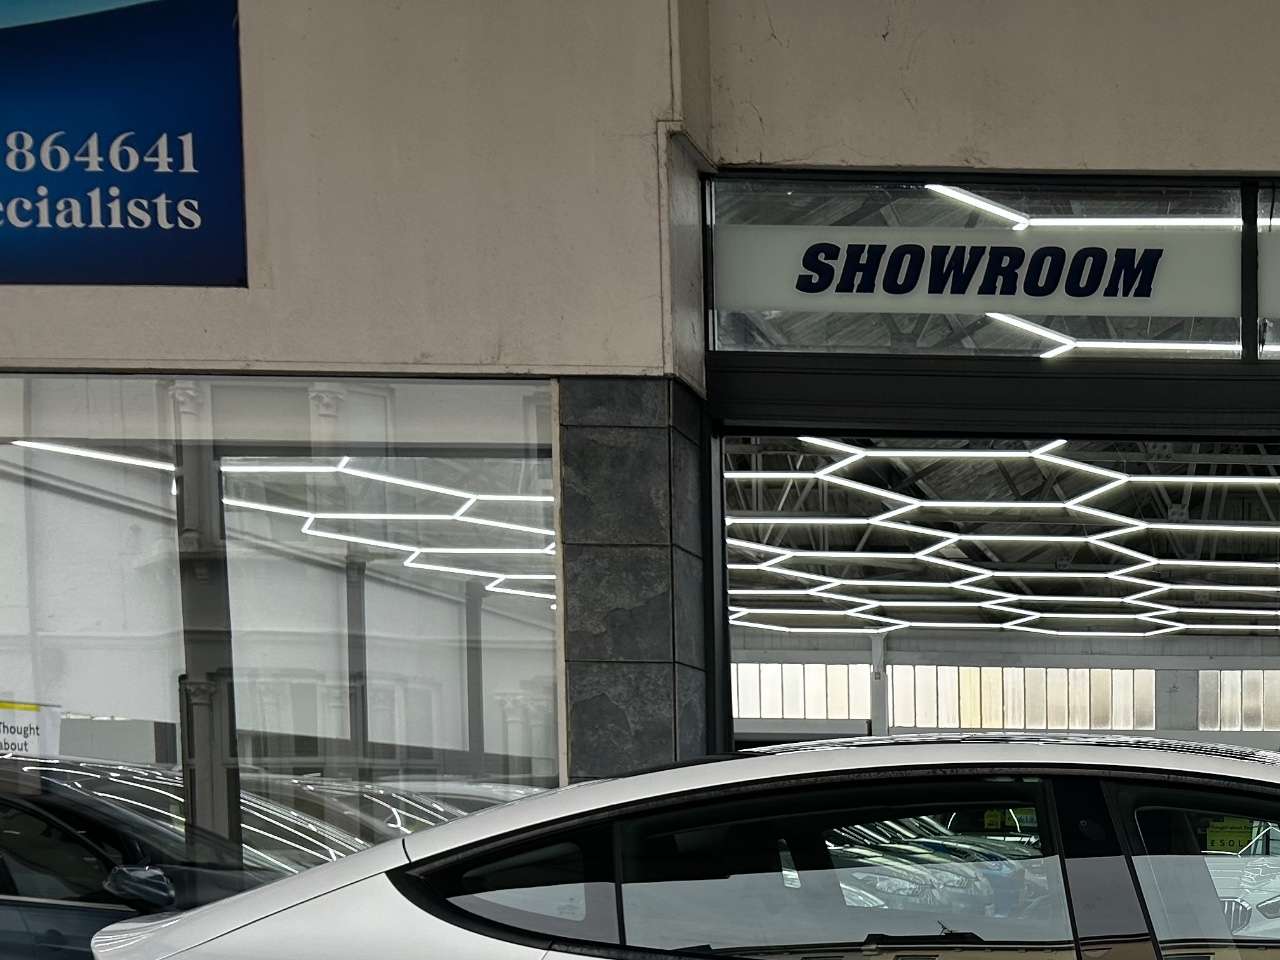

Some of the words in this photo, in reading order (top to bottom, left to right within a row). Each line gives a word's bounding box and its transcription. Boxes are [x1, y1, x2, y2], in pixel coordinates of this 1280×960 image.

[5, 131, 199, 173] 864641
[0, 186, 202, 230] cialists
[795, 242, 1164, 298] SHOWROOM
